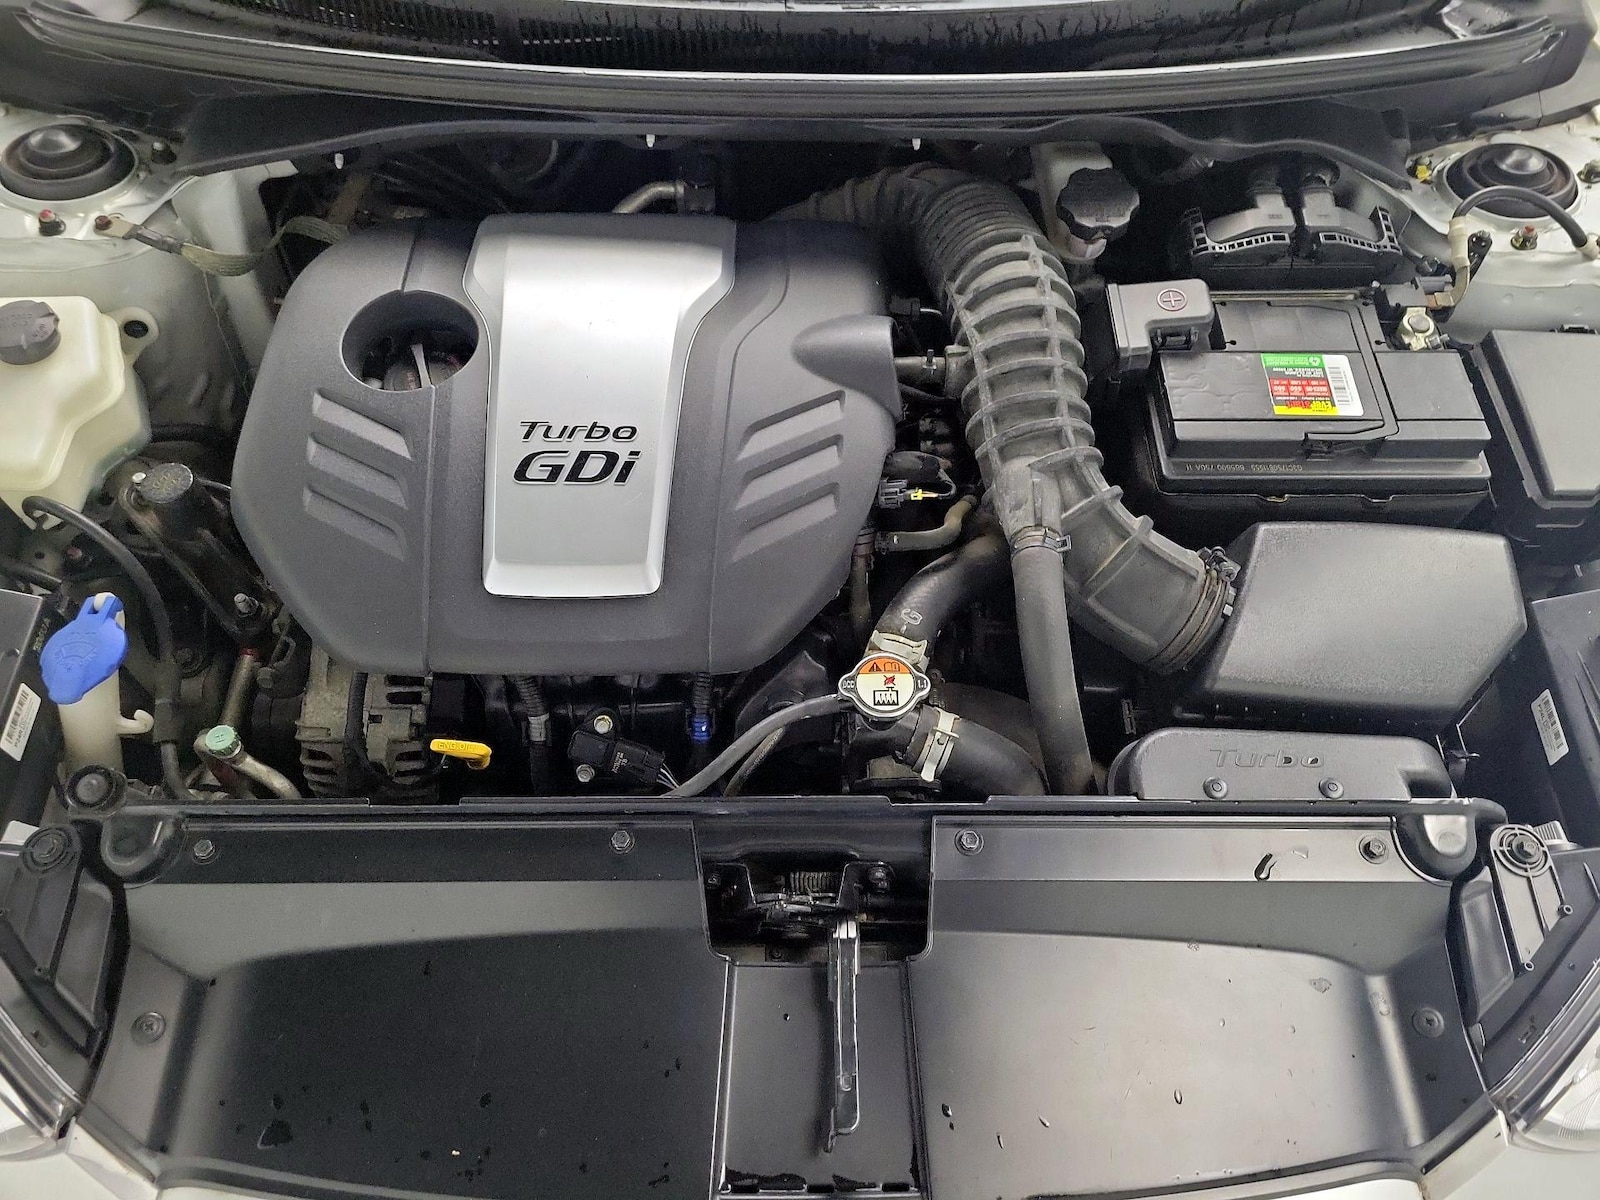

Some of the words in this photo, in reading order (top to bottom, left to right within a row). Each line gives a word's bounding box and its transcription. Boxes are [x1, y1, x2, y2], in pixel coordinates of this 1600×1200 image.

[520, 421, 638, 442] Turbo
[513, 450, 641, 485] GDi
[1210, 749, 1324, 768] Turbo
